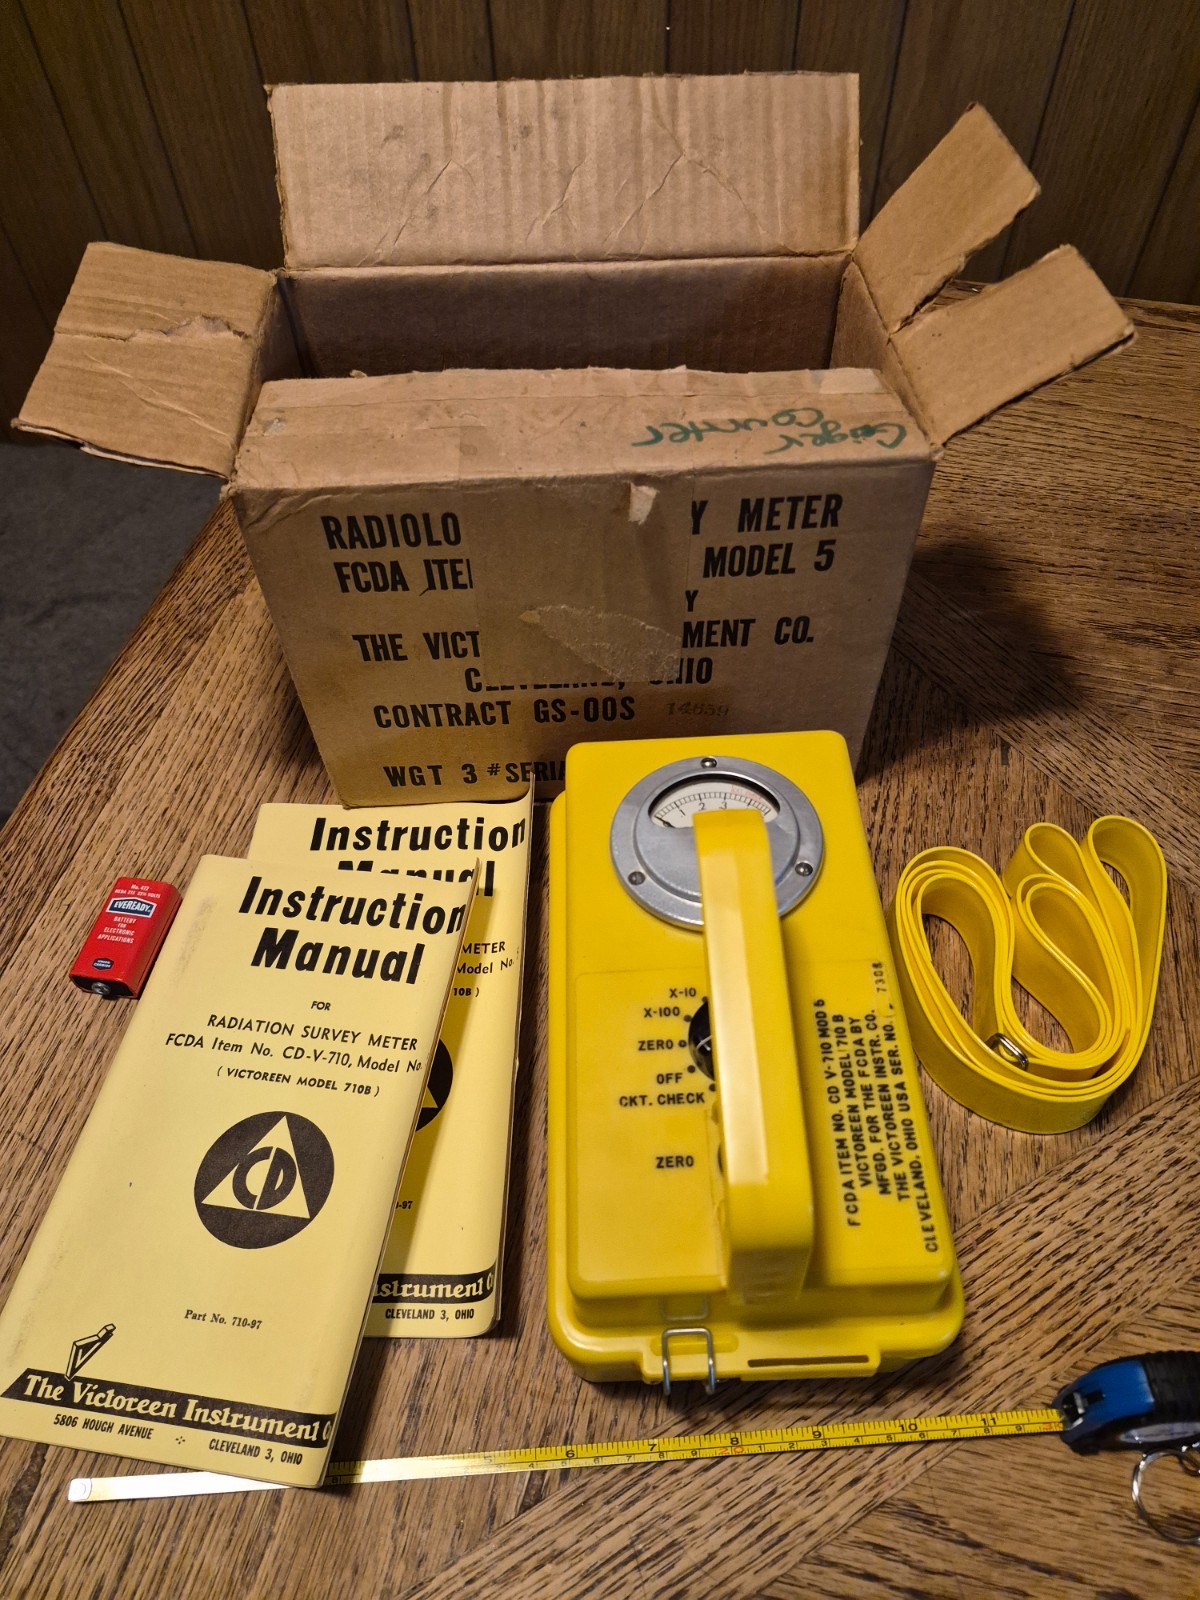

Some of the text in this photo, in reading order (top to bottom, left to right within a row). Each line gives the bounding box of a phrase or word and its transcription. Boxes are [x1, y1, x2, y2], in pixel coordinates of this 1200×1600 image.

[738, 494, 844, 533] METER
[333, 560, 410, 593] FCDA
[702, 542, 796, 579] MODEL
[813, 539, 837, 572] 5
[352, 633, 409, 663] THE
[682, 618, 757, 649] MENT
[773, 615, 815, 646] CO.
[373, 700, 512, 729] CONTRACT
[383, 764, 443, 788] WGT
[461, 763, 478, 785] 3
[698, 802, 706, 811] 2
[310, 817, 526, 851] Instruction
[113, 900, 151, 912] EVEREADY
[113, 916, 137, 924] BATTERY
[238, 876, 467, 935] Instruction
[97, 933, 135, 944] APPLICATIONS
[103, 926, 136, 936] ELECTRONIC
[250, 927, 425, 984] Manual
[310, 1000, 331, 1011] FOR
[669, 987, 697, 999] X-10
[643, 1006, 681, 1018] X-100
[814, 1011, 830, 1038] MOD
[832, 1014, 844, 1022] B
[207, 1014, 418, 1051] RADIATION SURVEY METER
[638, 1039, 674, 1051] ZERO
[165, 1033, 204, 1049] FCDA
[211, 1037, 243, 1053] Item
[250, 1042, 273, 1058] No.
[282, 1046, 352, 1068] CD-V-710,
[357, 1054, 400, 1073] Model
[887, 1044, 904, 1075] SER.
[296, 1077, 338, 1091] MODEL
[656, 1072, 684, 1085] OFF
[839, 1053, 857, 1099] MODEL
[619, 1092, 705, 1107] CKT. CHECK
[848, 1017, 891, 1195] MFGD. FOR THE FCDA BY
[864, 1009, 910, 1202] THE VICTOREEN INSTR. CO.
[894, 1081, 911, 1112] USA
[831, 1110, 845, 1132] NO.
[901, 1118, 918, 1150] OHIO
[834, 1138, 852, 1175] ITEM
[847, 1104, 873, 1188] VICTOREEN
[656, 1155, 695, 1169] ZERO
[842, 1179, 861, 1228] FCDA
[184, 1309, 263, 1330] Part No. 710-97
[385, 1308, 475, 1322] CLEVELAND 3, OHIO
[23, 1374, 64, 1401] The
[71, 1381, 177, 1419] Victoreen
[181, 1398, 321, 1442] Instrument
[53, 1412, 304, 1466] 5806 HOUGH AVENUE CLEVELAND 3, OHIO
[565, 1449, 575, 1459] 6
[648, 1443, 658, 1452] 7
[730, 1436, 740, 1446] 8
[811, 1429, 822, 1439] 9
[899, 1423, 918, 1432] 10
[980, 1417, 997, 1426] 11
[658, 1451, 665, 1459] 8
[690, 1449, 698, 1457] 9
[788, 1442, 796, 1450] 2
[820, 1439, 829, 1447] 3
[853, 1436, 861, 1444] 4
[886, 1434, 893, 1442] 5
[918, 1431, 926, 1439] 6
[983, 1426, 991, 1435] 8
[1015, 1424, 1023, 1433] 9
